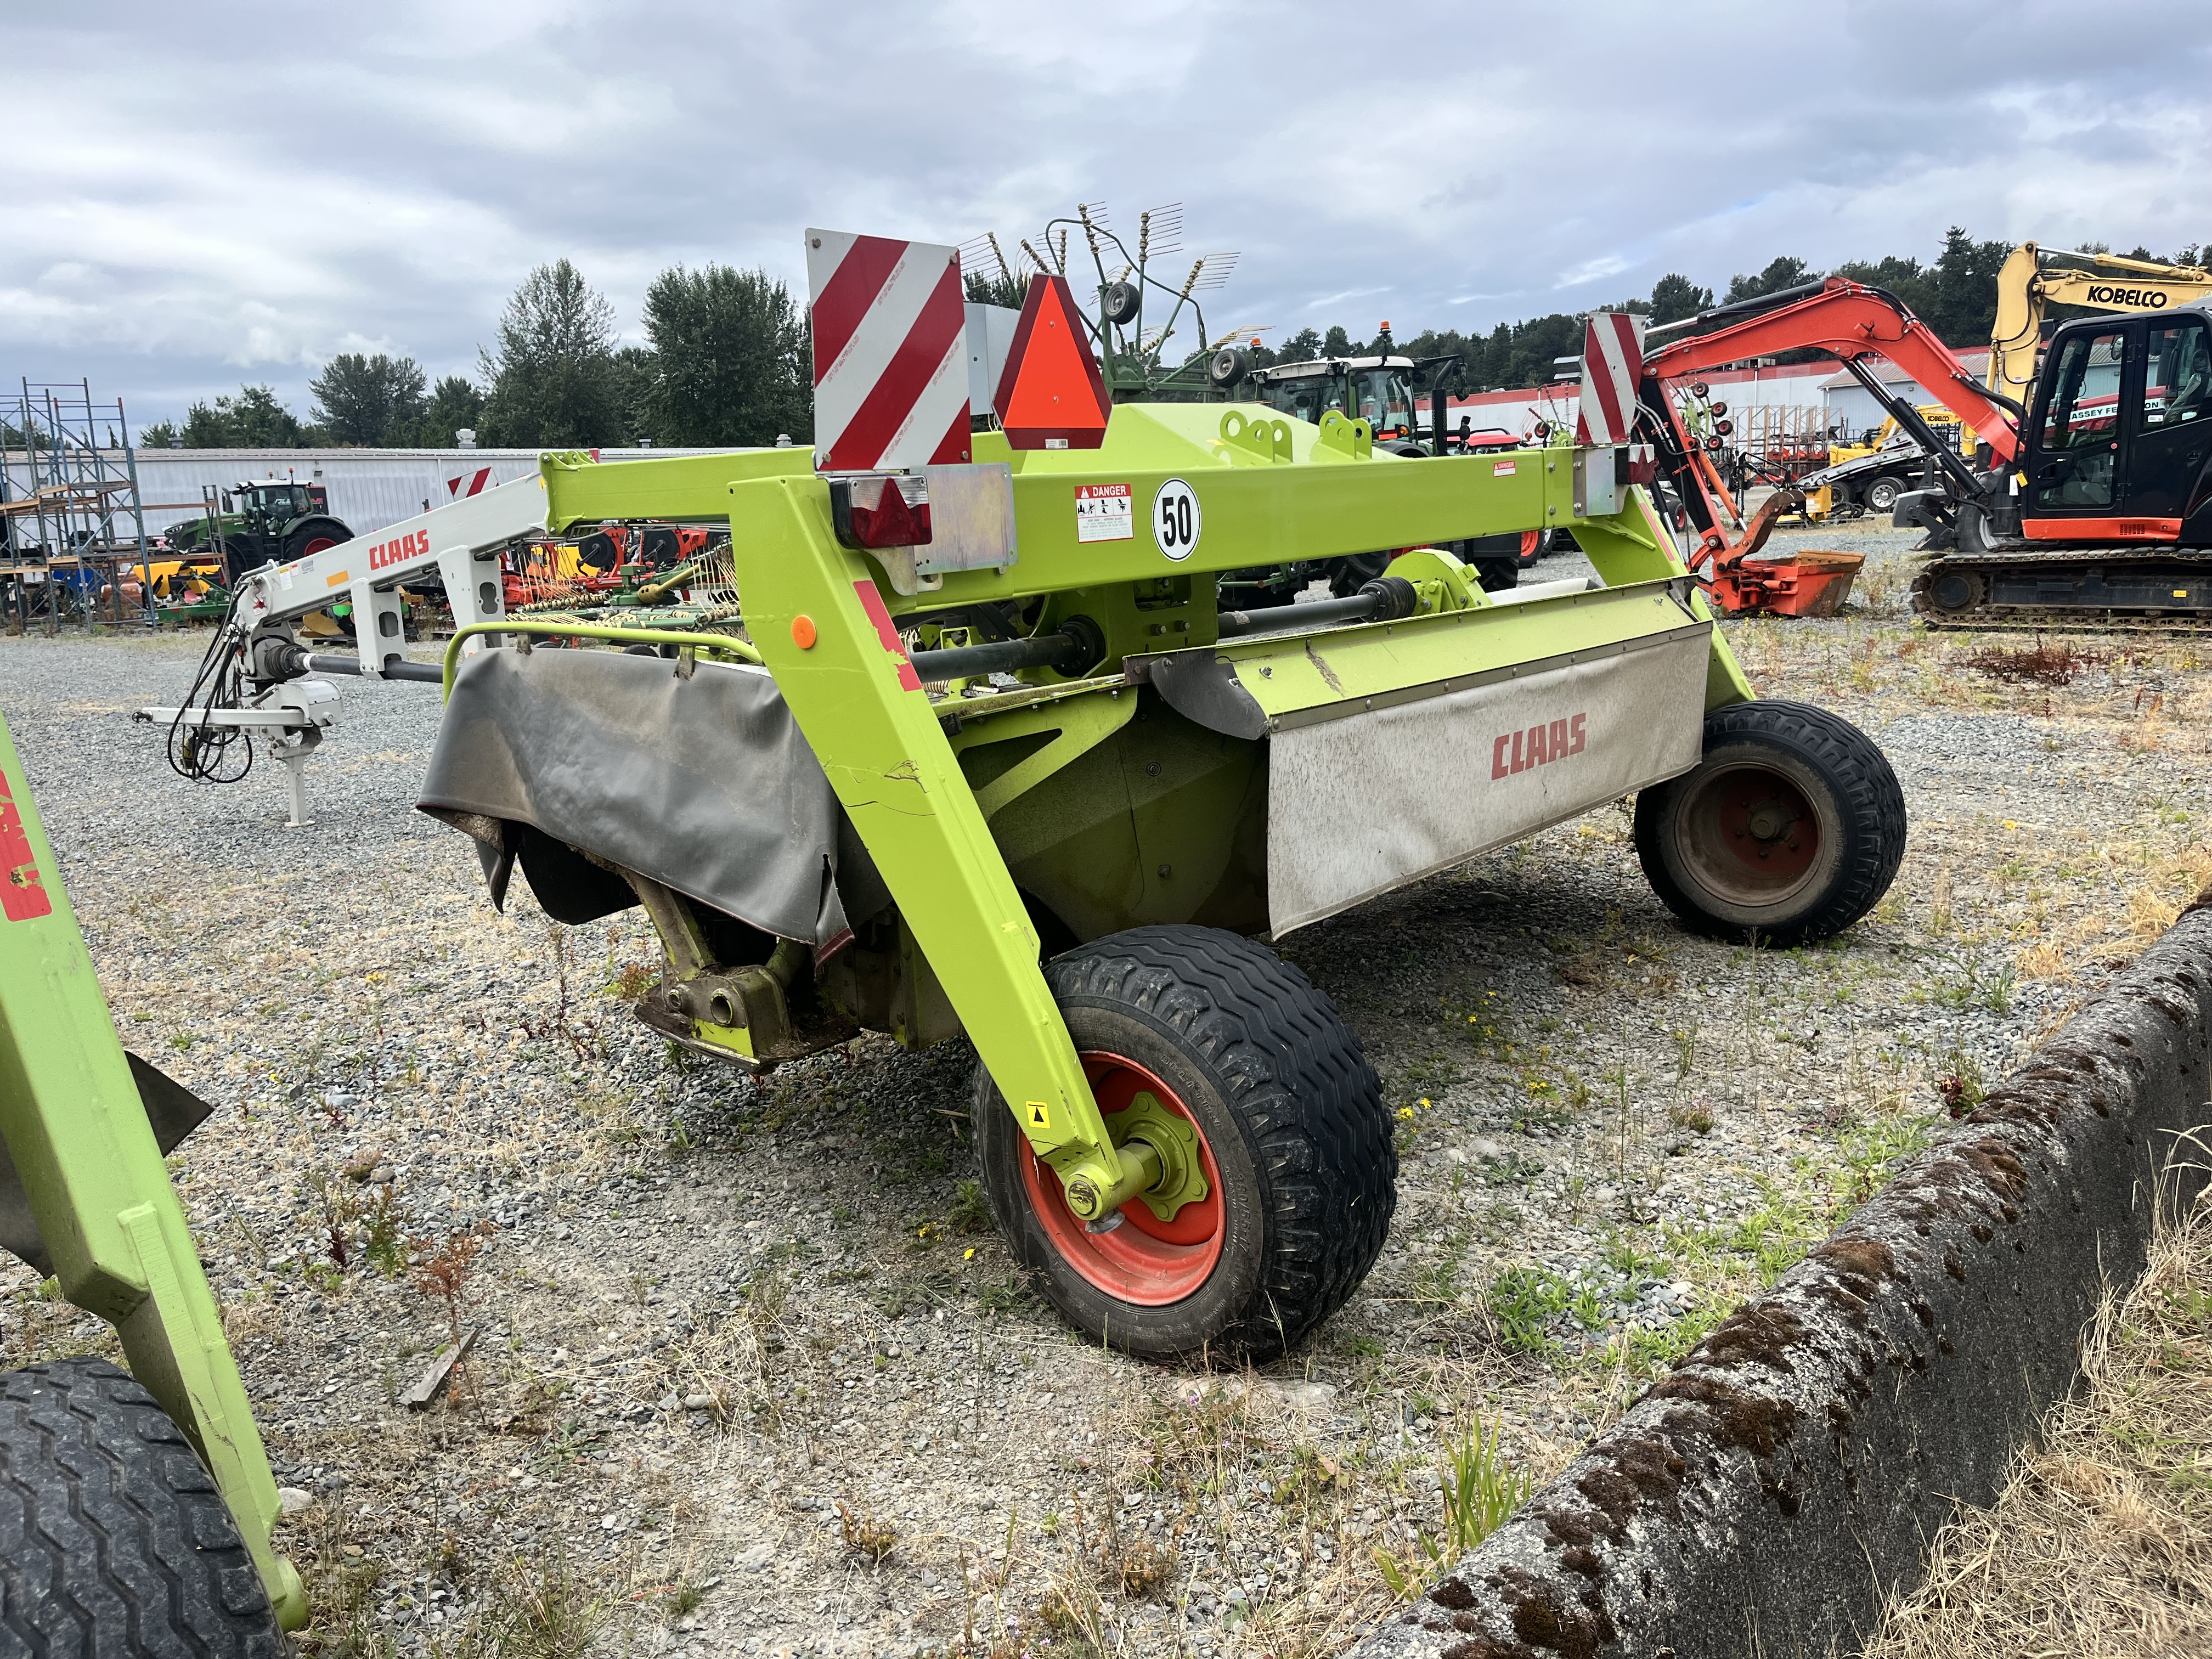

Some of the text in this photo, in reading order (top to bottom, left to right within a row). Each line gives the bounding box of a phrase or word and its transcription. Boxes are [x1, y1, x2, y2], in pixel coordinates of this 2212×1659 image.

[2086, 285, 2167, 308] KOBELCO
[2072, 409, 2103, 420] ASSEY
[1092, 485, 1126, 497] DANGER
[1162, 495, 1192, 547] 50
[369, 529, 429, 571] CLAAS
[1491, 712, 1586, 781] CLAAS
